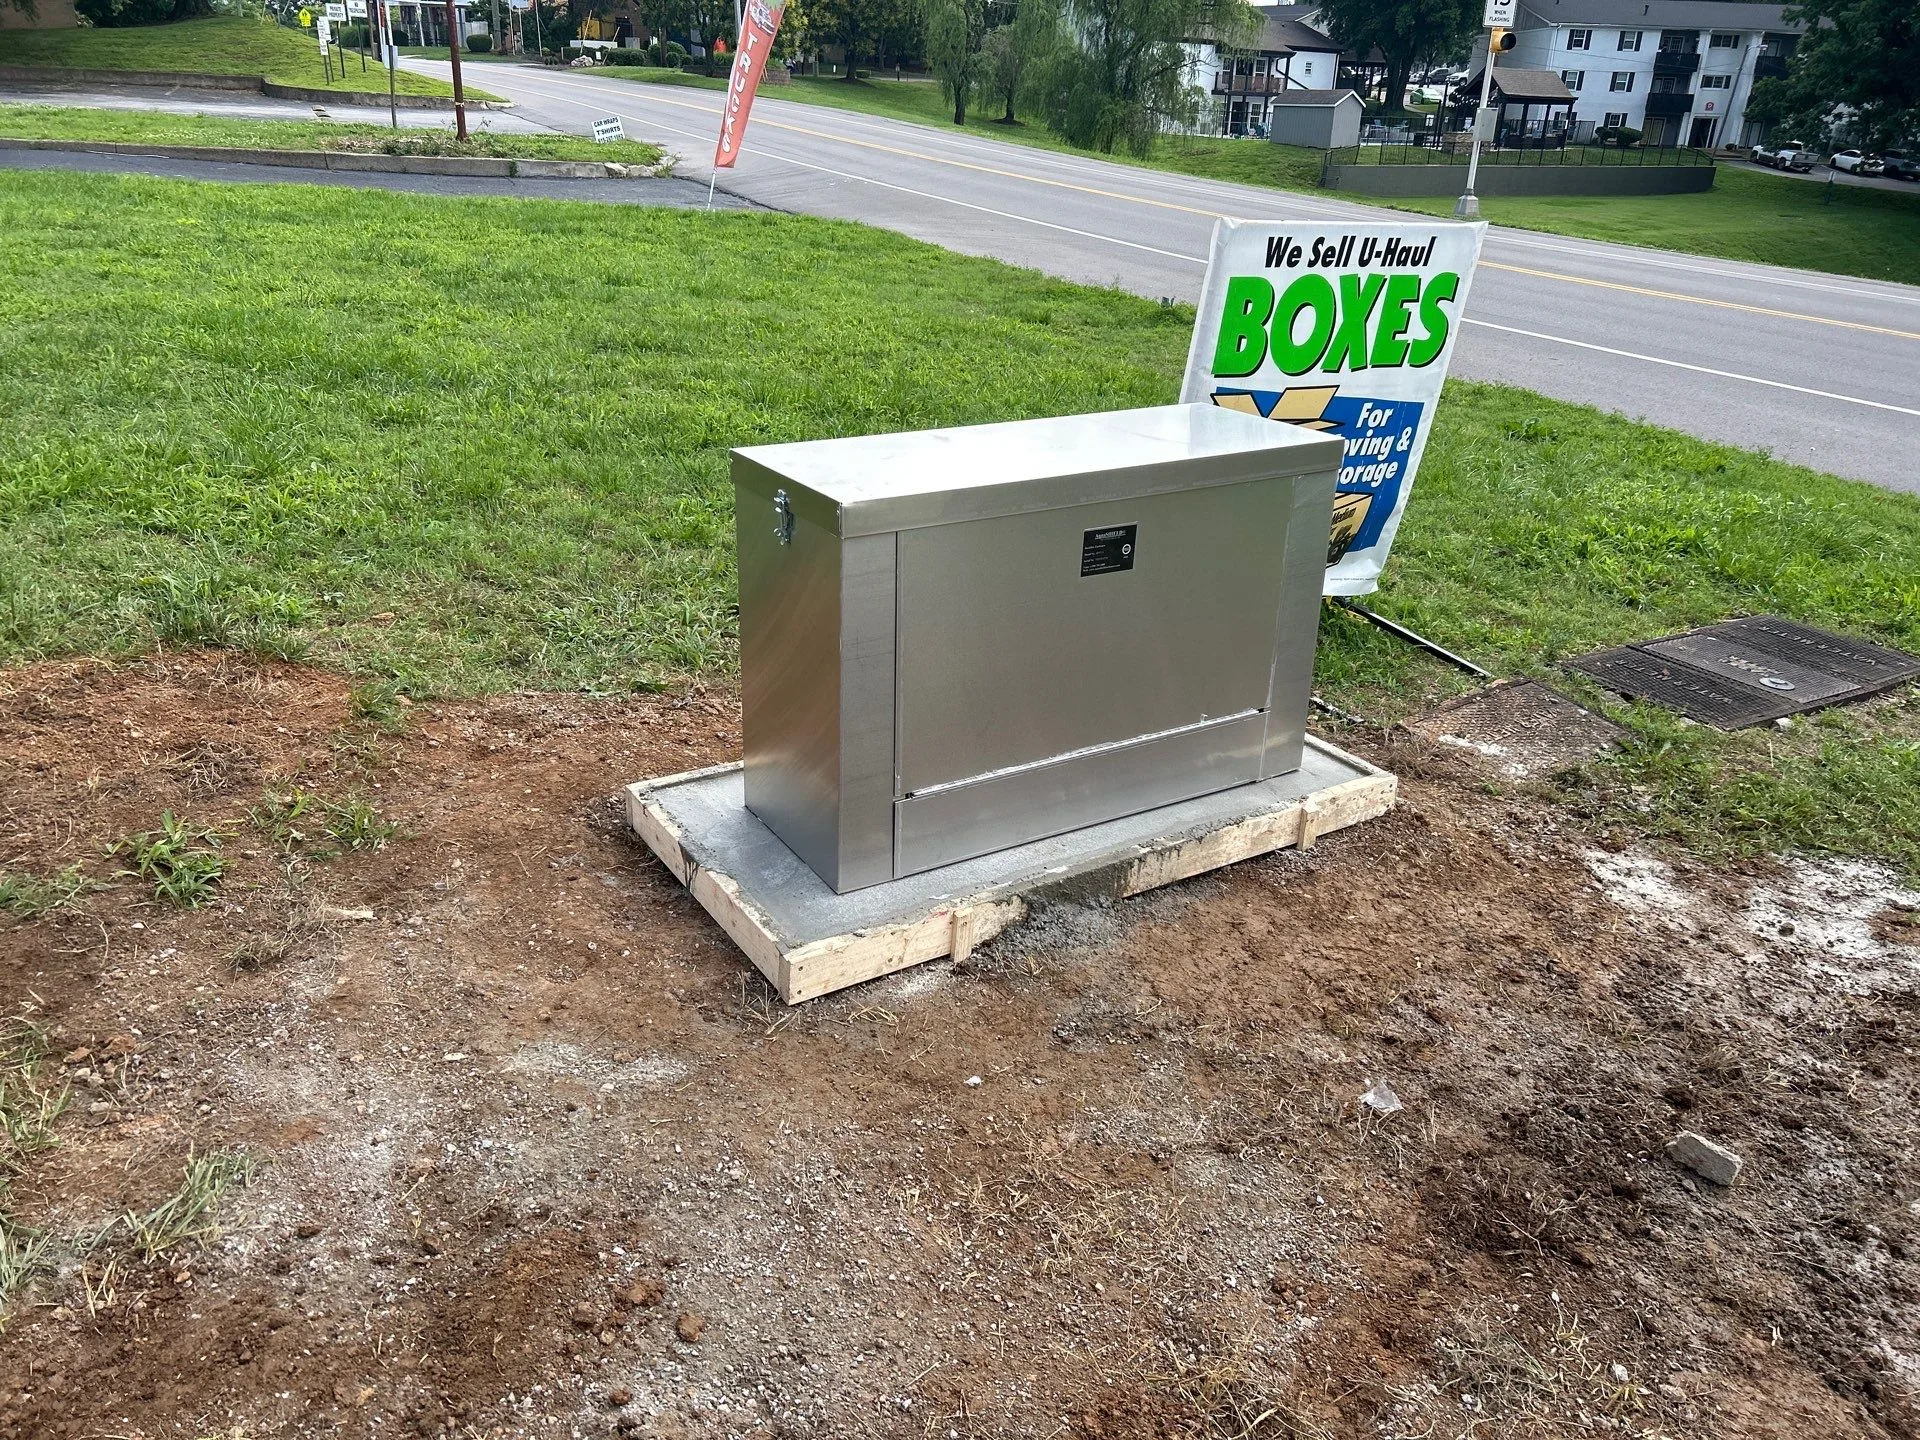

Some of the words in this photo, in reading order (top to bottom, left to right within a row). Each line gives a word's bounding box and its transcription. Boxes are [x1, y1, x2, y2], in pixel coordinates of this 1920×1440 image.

[722, 31, 758, 153] TRUCKS
[603, 117, 619, 125] WRAPS
[1265, 236, 1303, 268] We
[1307, 236, 1357, 268] Sell
[1357, 235, 1438, 267] U-Haul
[1211, 271, 1460, 378] BOXES
[1356, 402, 1394, 429] For
[1396, 426, 1412, 452] &
[1338, 461, 1399, 488] orage
